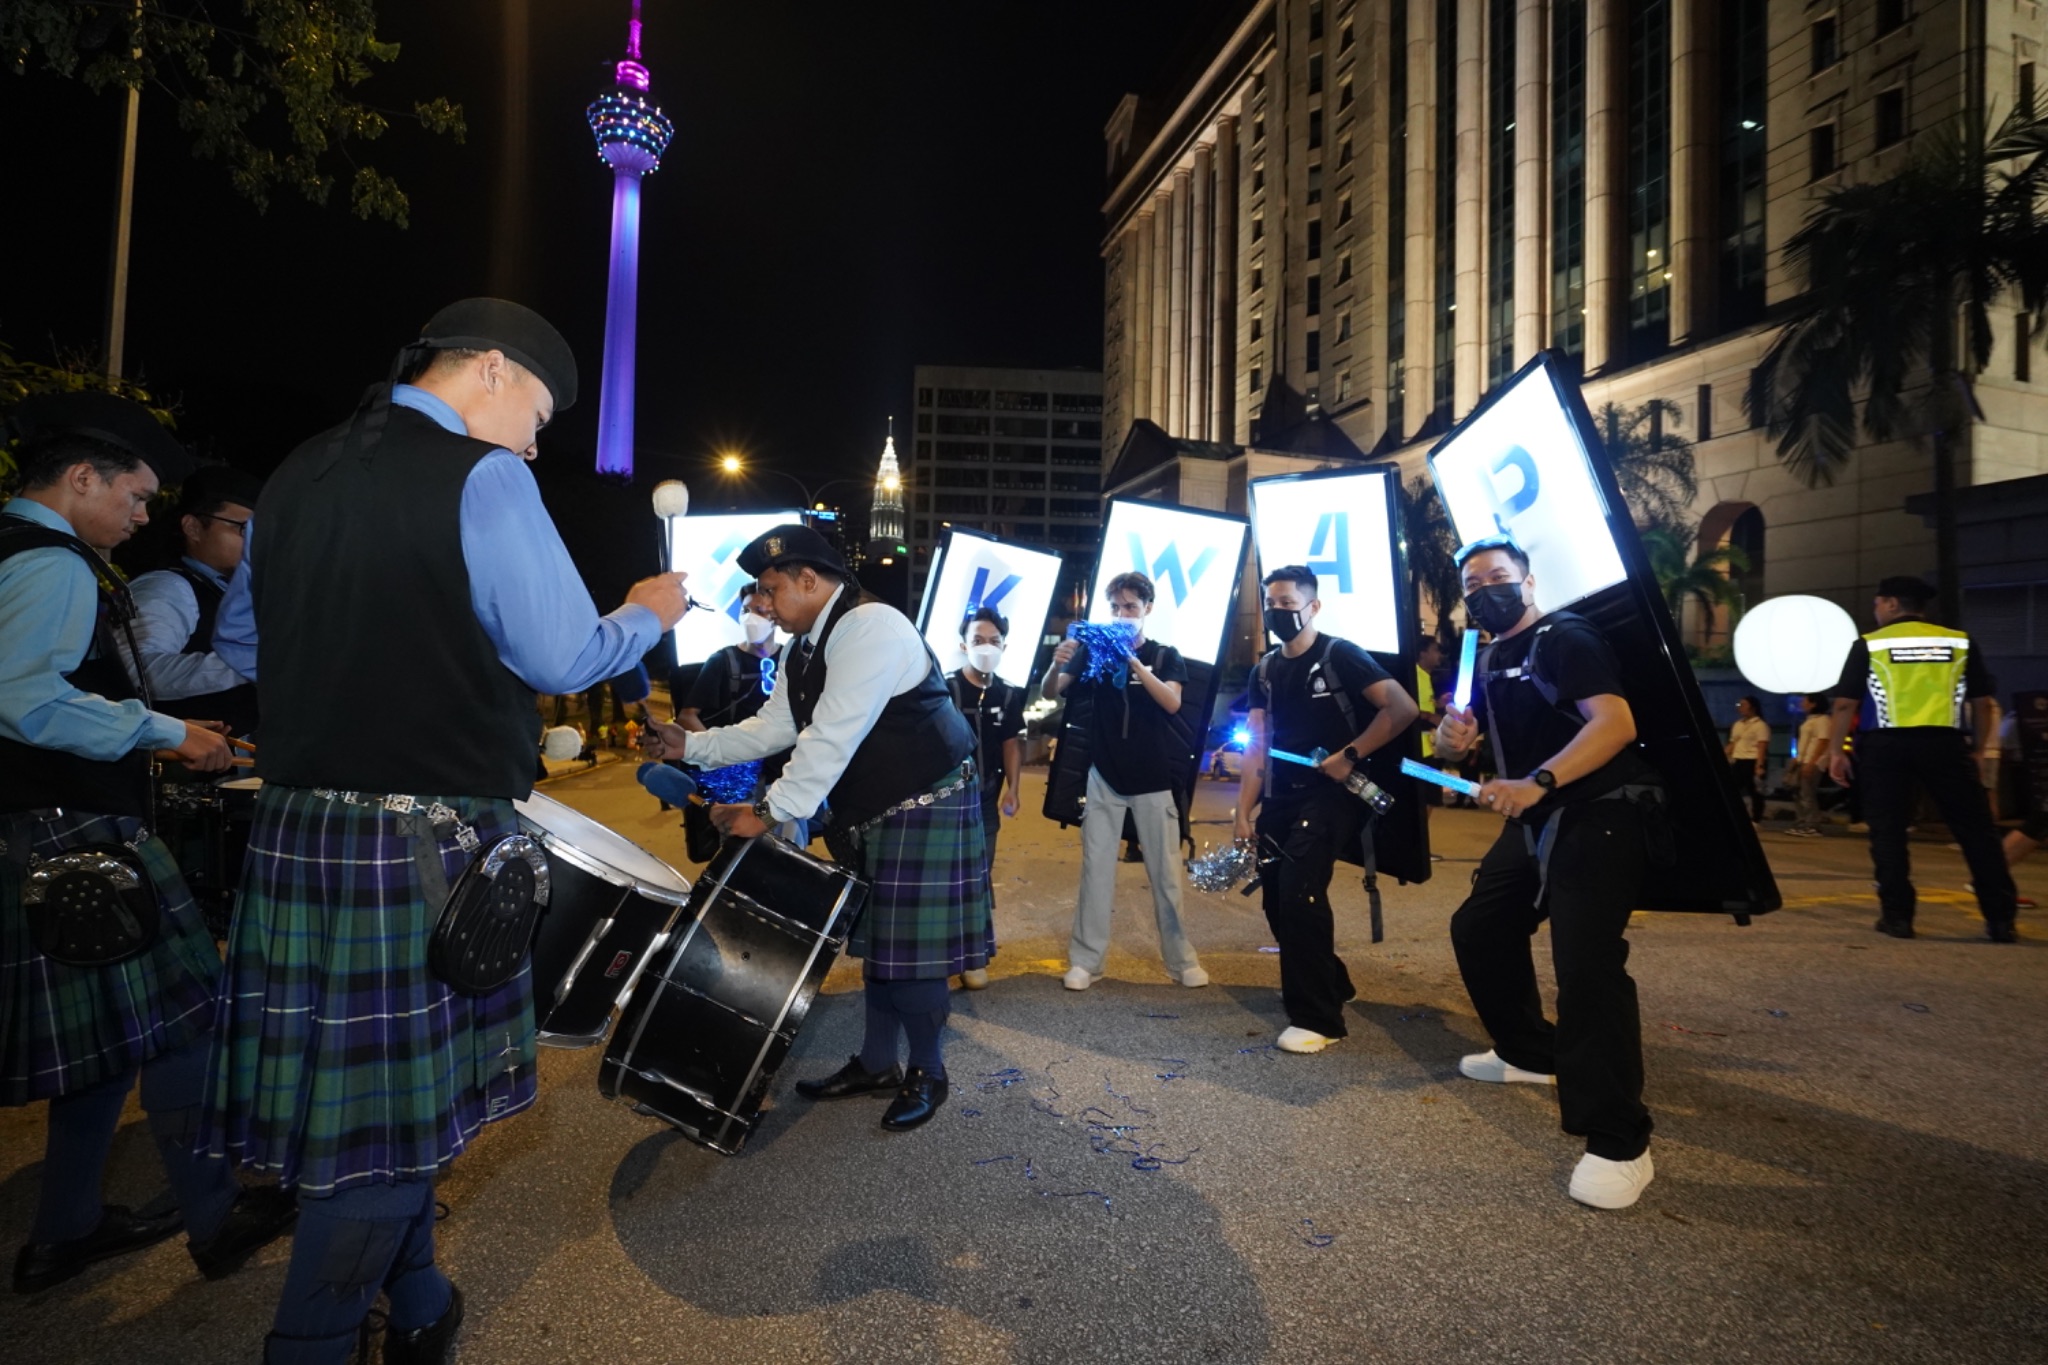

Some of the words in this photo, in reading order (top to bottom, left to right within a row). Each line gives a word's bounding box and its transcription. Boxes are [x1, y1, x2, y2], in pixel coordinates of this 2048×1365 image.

[1477, 444, 1540, 538] P
[1126, 531, 1219, 609] W
[1306, 511, 1353, 594] A
[962, 566, 1022, 621] K
